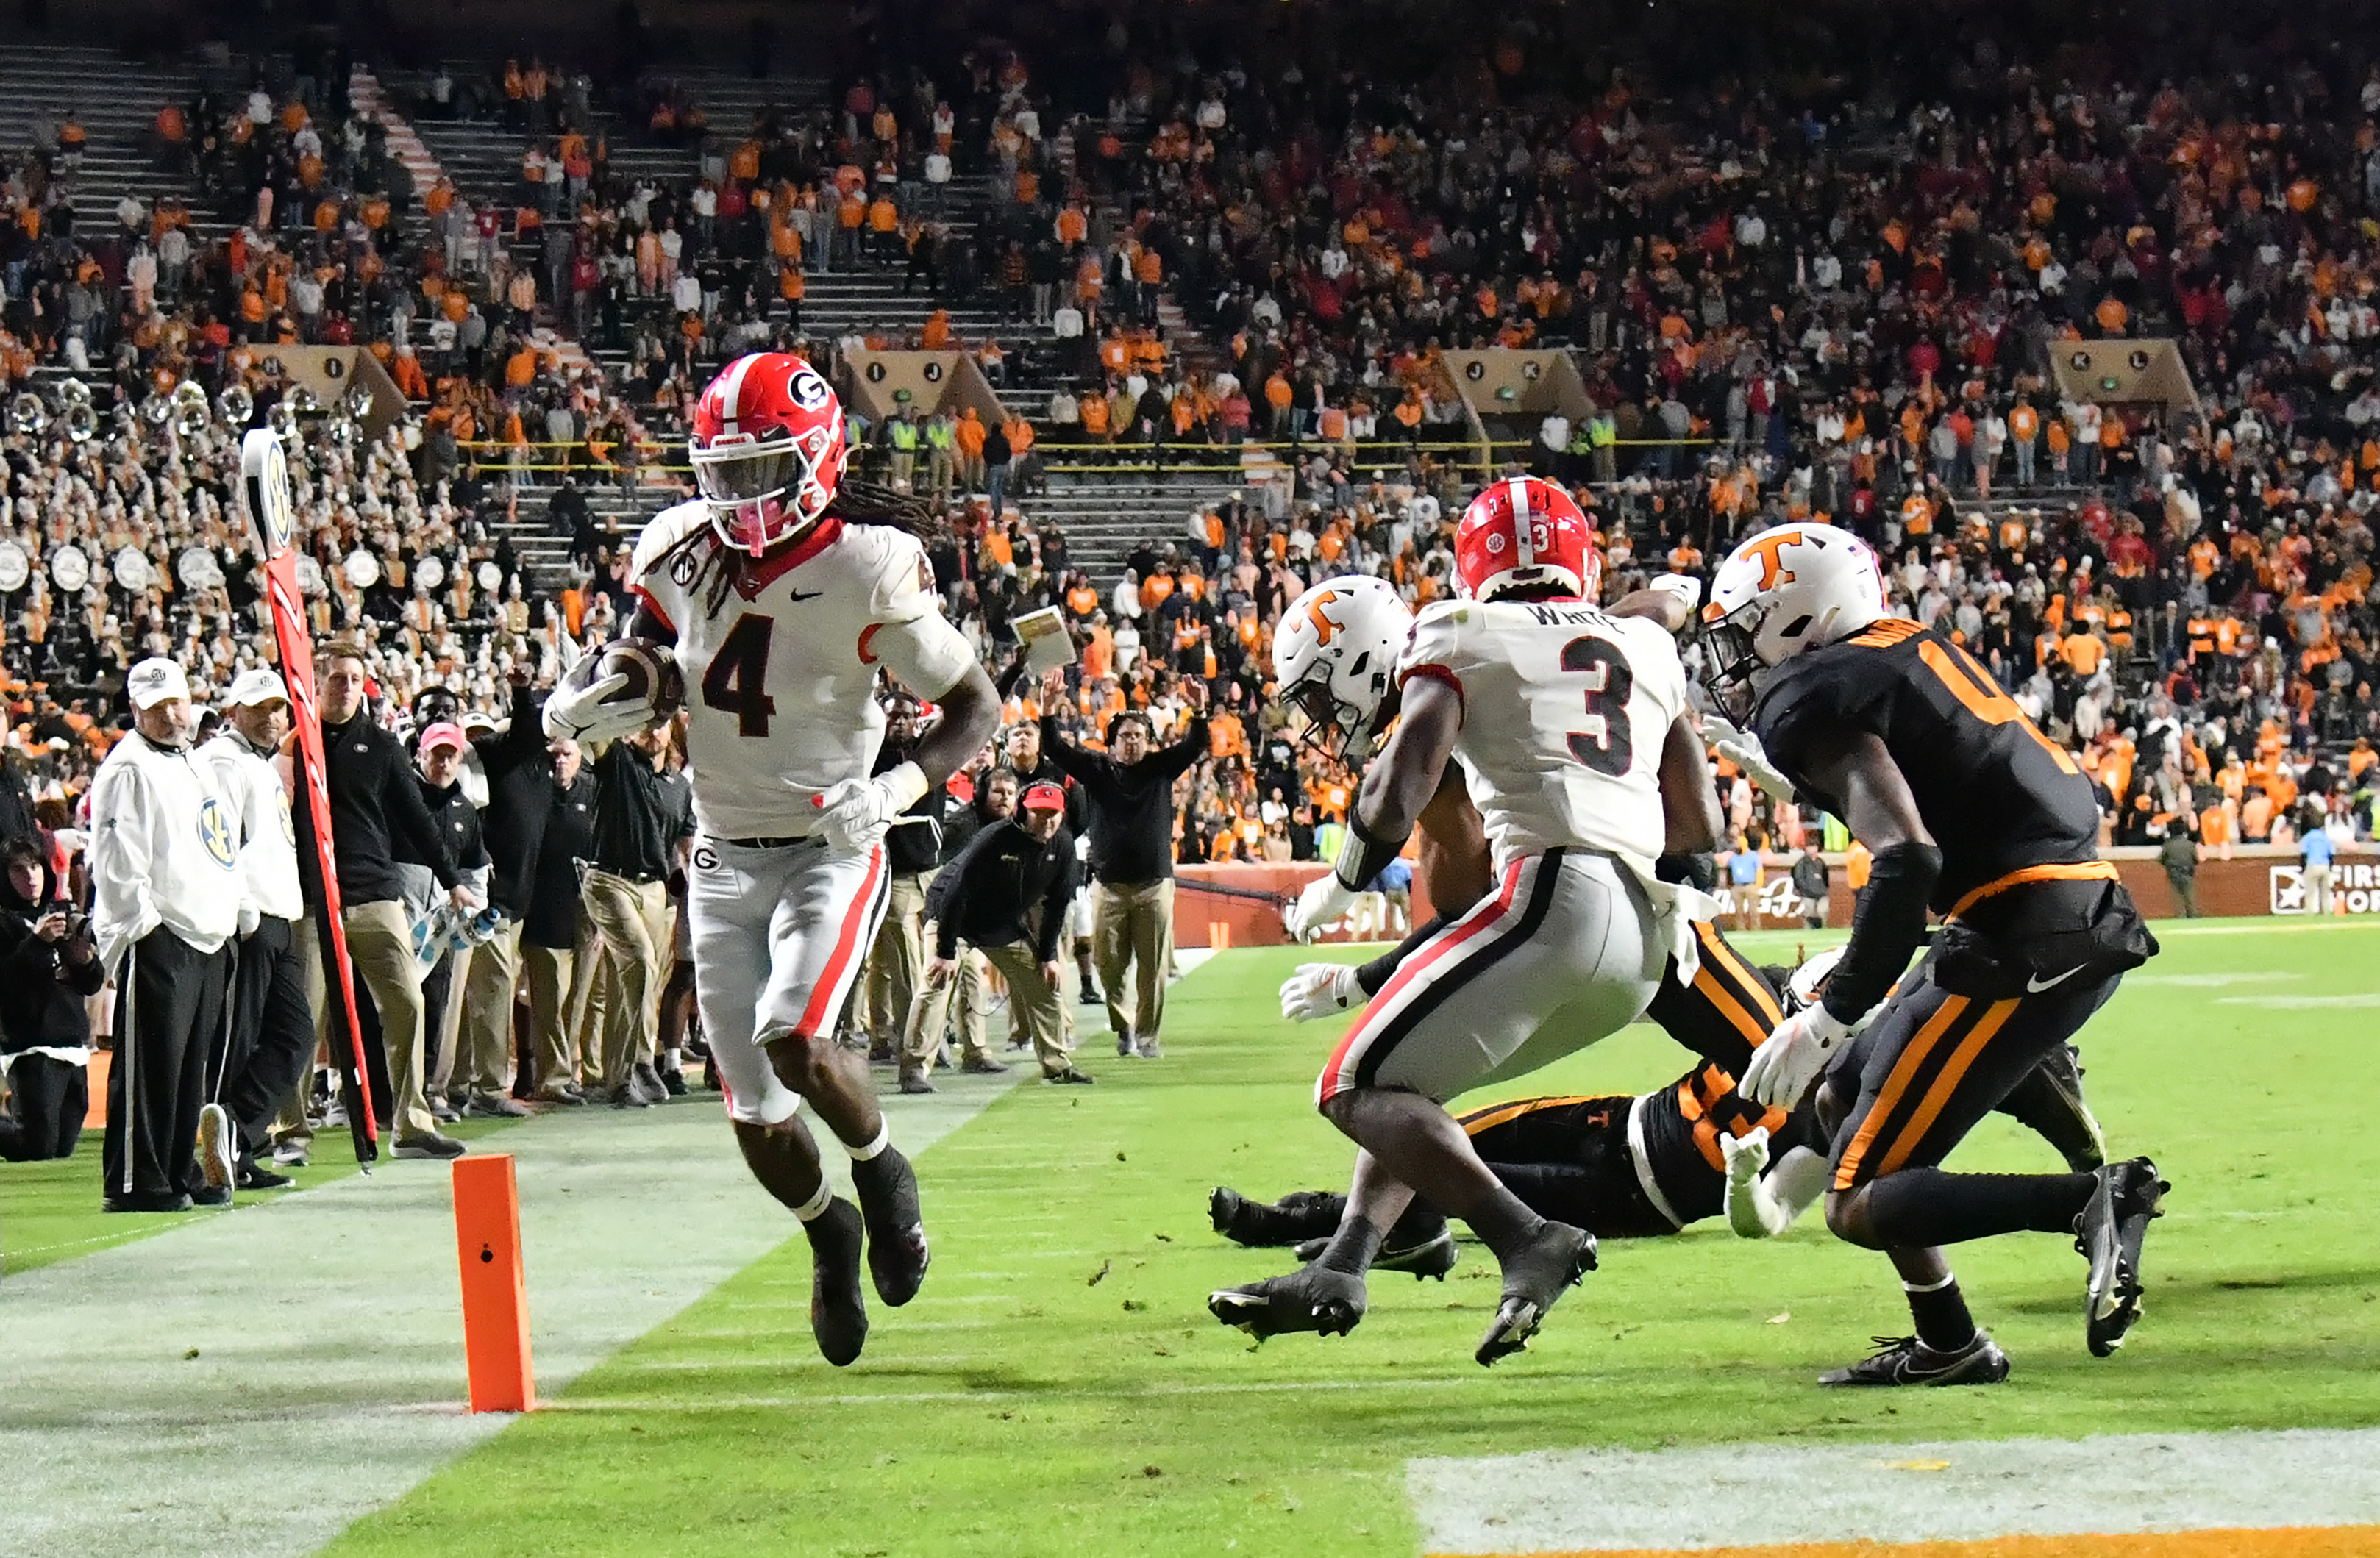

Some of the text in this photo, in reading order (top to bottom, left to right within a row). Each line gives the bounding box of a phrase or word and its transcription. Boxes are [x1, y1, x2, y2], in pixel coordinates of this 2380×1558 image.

[789, 371, 828, 410] G
[1532, 523, 1549, 553] 3
[1738, 531, 1803, 593] T
[1289, 589, 1346, 648] T
[1526, 605, 1626, 635] WHITE
[701, 612, 777, 737] 4
[1560, 635, 1633, 779] 3
[694, 848, 719, 871] G
[1586, 1109, 1609, 1129] T
